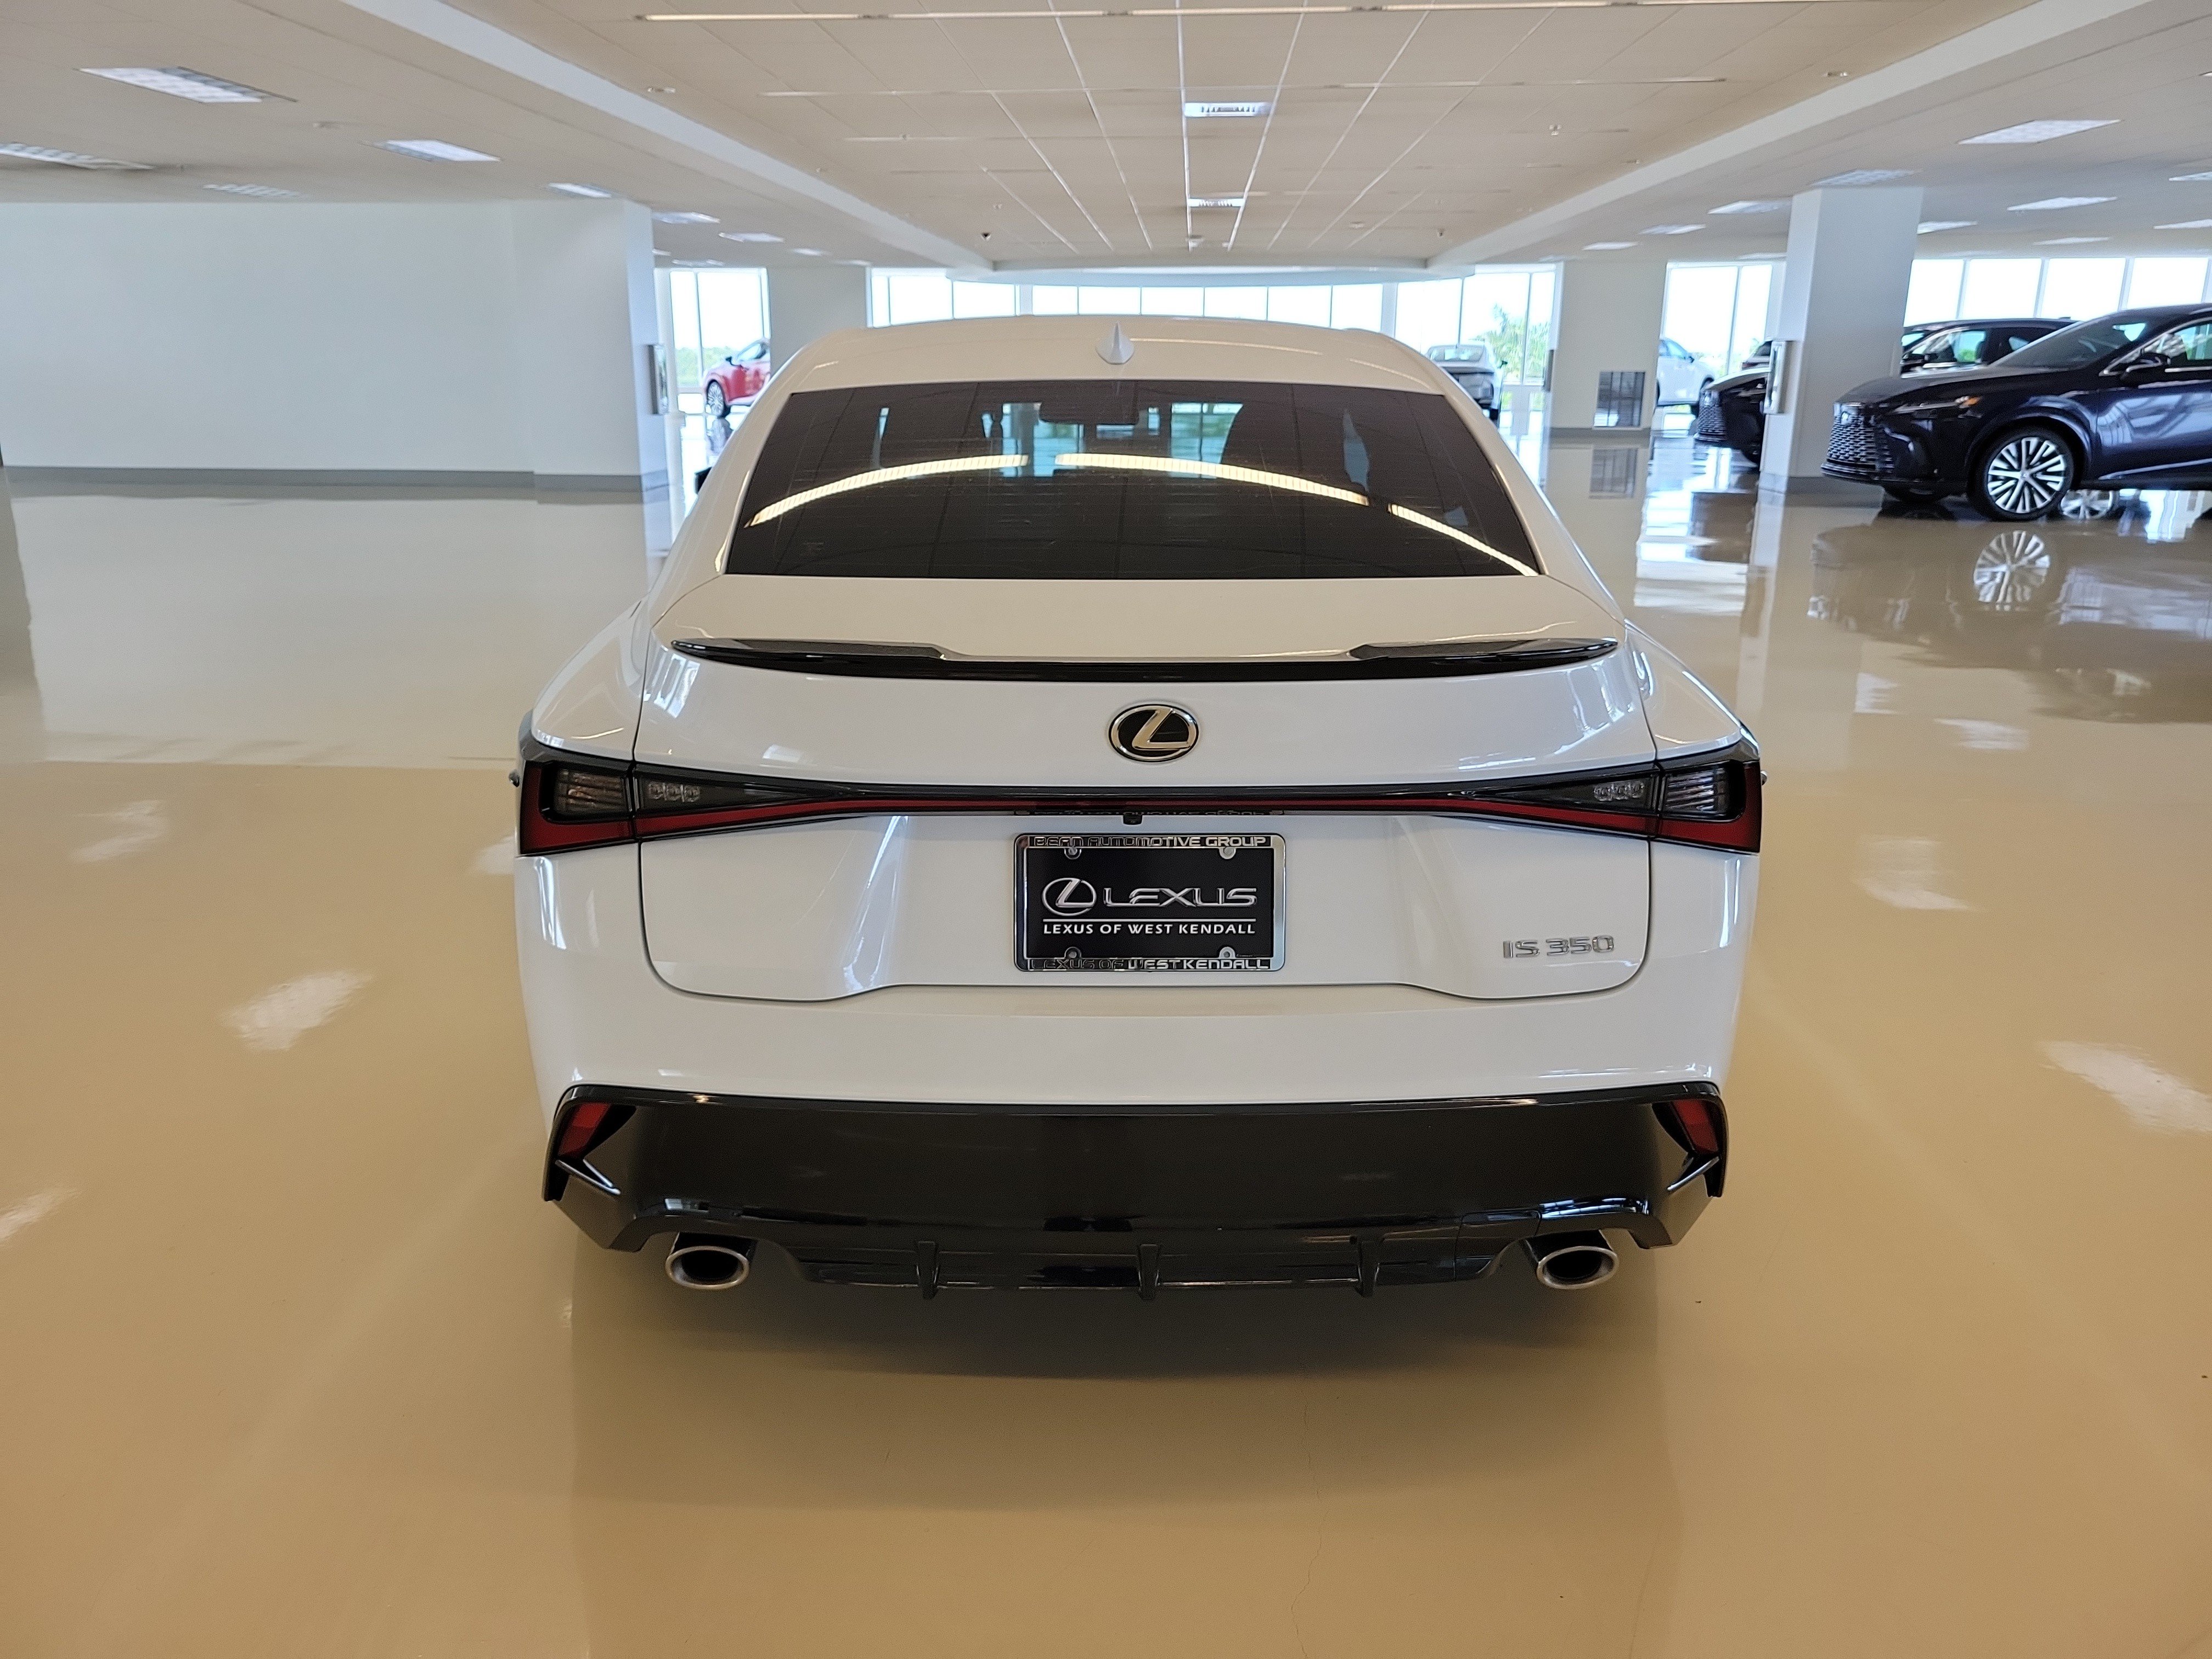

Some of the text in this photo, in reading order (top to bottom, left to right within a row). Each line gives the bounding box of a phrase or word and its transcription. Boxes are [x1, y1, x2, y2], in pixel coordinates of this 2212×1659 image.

[1034, 836, 1266, 847] BEAN AUTOMOTIVE GROUP
[1103, 888, 1257, 907] LEXUS
[1043, 924, 1256, 934] LEXUS OF WEST KENDALL
[1503, 935, 1615, 958] IS 350
[1031, 959, 1269, 969] LEXUS OF WEST KENDALL
